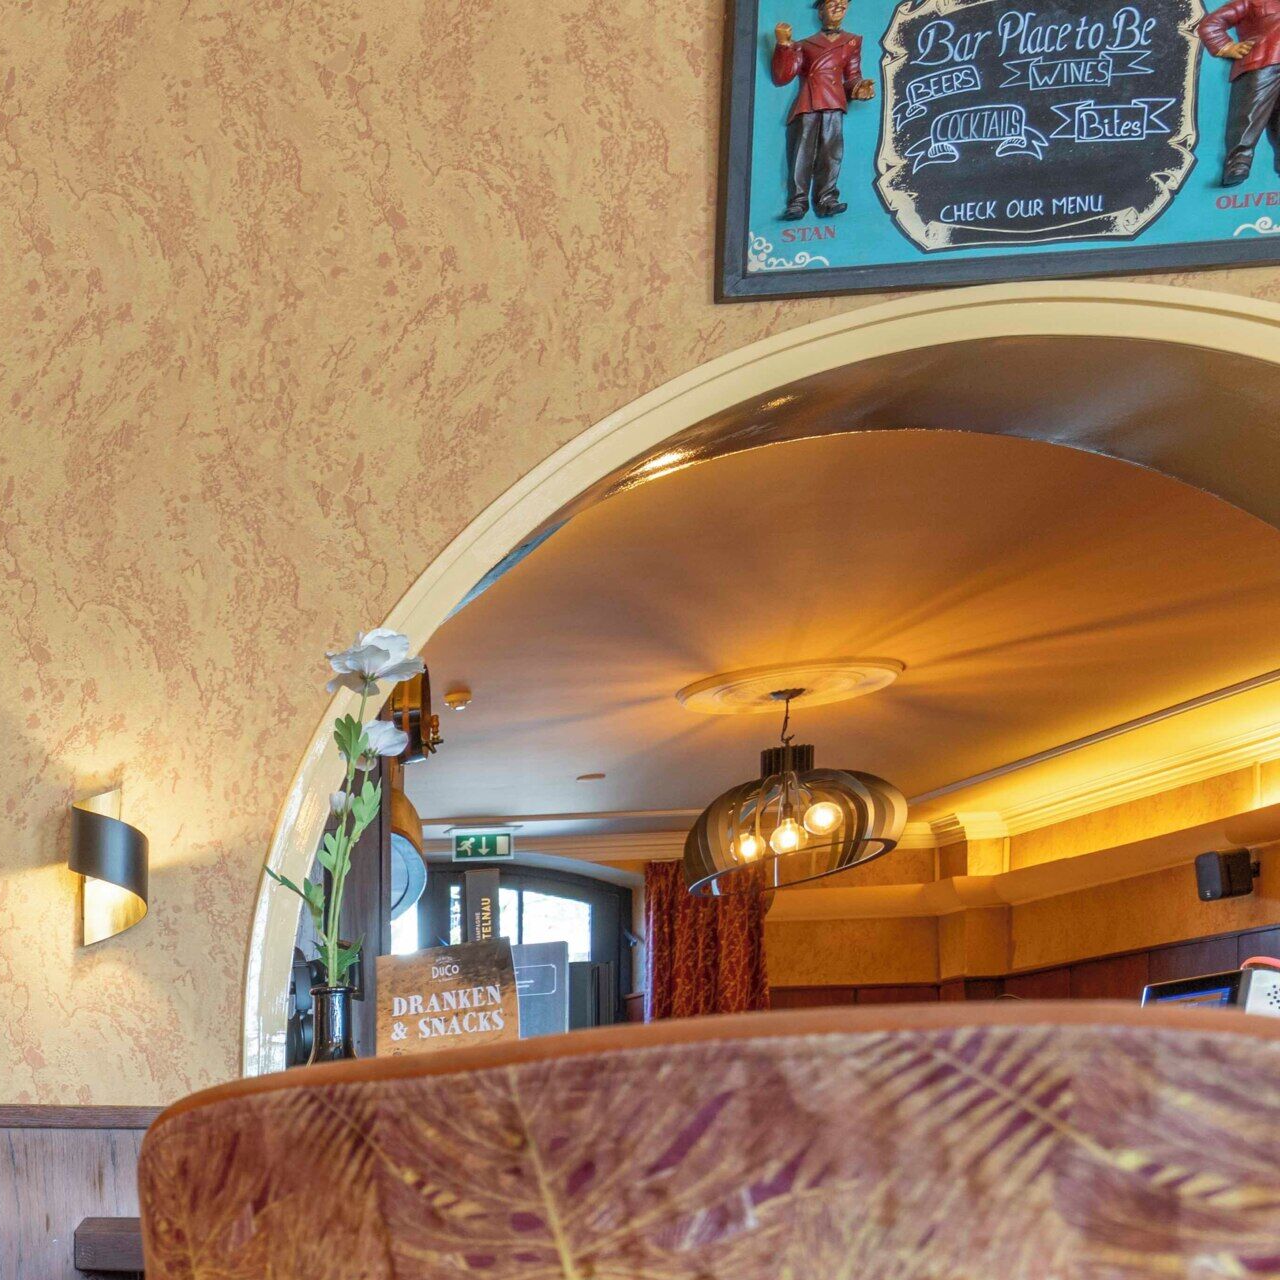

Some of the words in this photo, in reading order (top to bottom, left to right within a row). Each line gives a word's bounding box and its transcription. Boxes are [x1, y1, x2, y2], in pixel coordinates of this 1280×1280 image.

[910, 20, 993, 65] Bar
[997, 11, 1072, 57] Place
[1075, 16, 1104, 50] to
[1105, 6, 1157, 51] Be
[910, 69, 976, 101] BEERS
[1032, 61, 1109, 86] WINES
[936, 109, 1020, 141] COCKTAILS
[1079, 109, 1142, 140] Bites
[940, 200, 997, 222] CHECK
[1006, 198, 1044, 219] OUR
[1052, 195, 1103, 215] MENU
[1215, 191, 1280, 210] OLIVE
[781, 225, 836, 243] STAN
[481, 897, 492, 940] TELNAU
[391, 984, 502, 1018] DRANKEN
[390, 1021, 408, 1041] &
[418, 1008, 505, 1039] SNACKS
